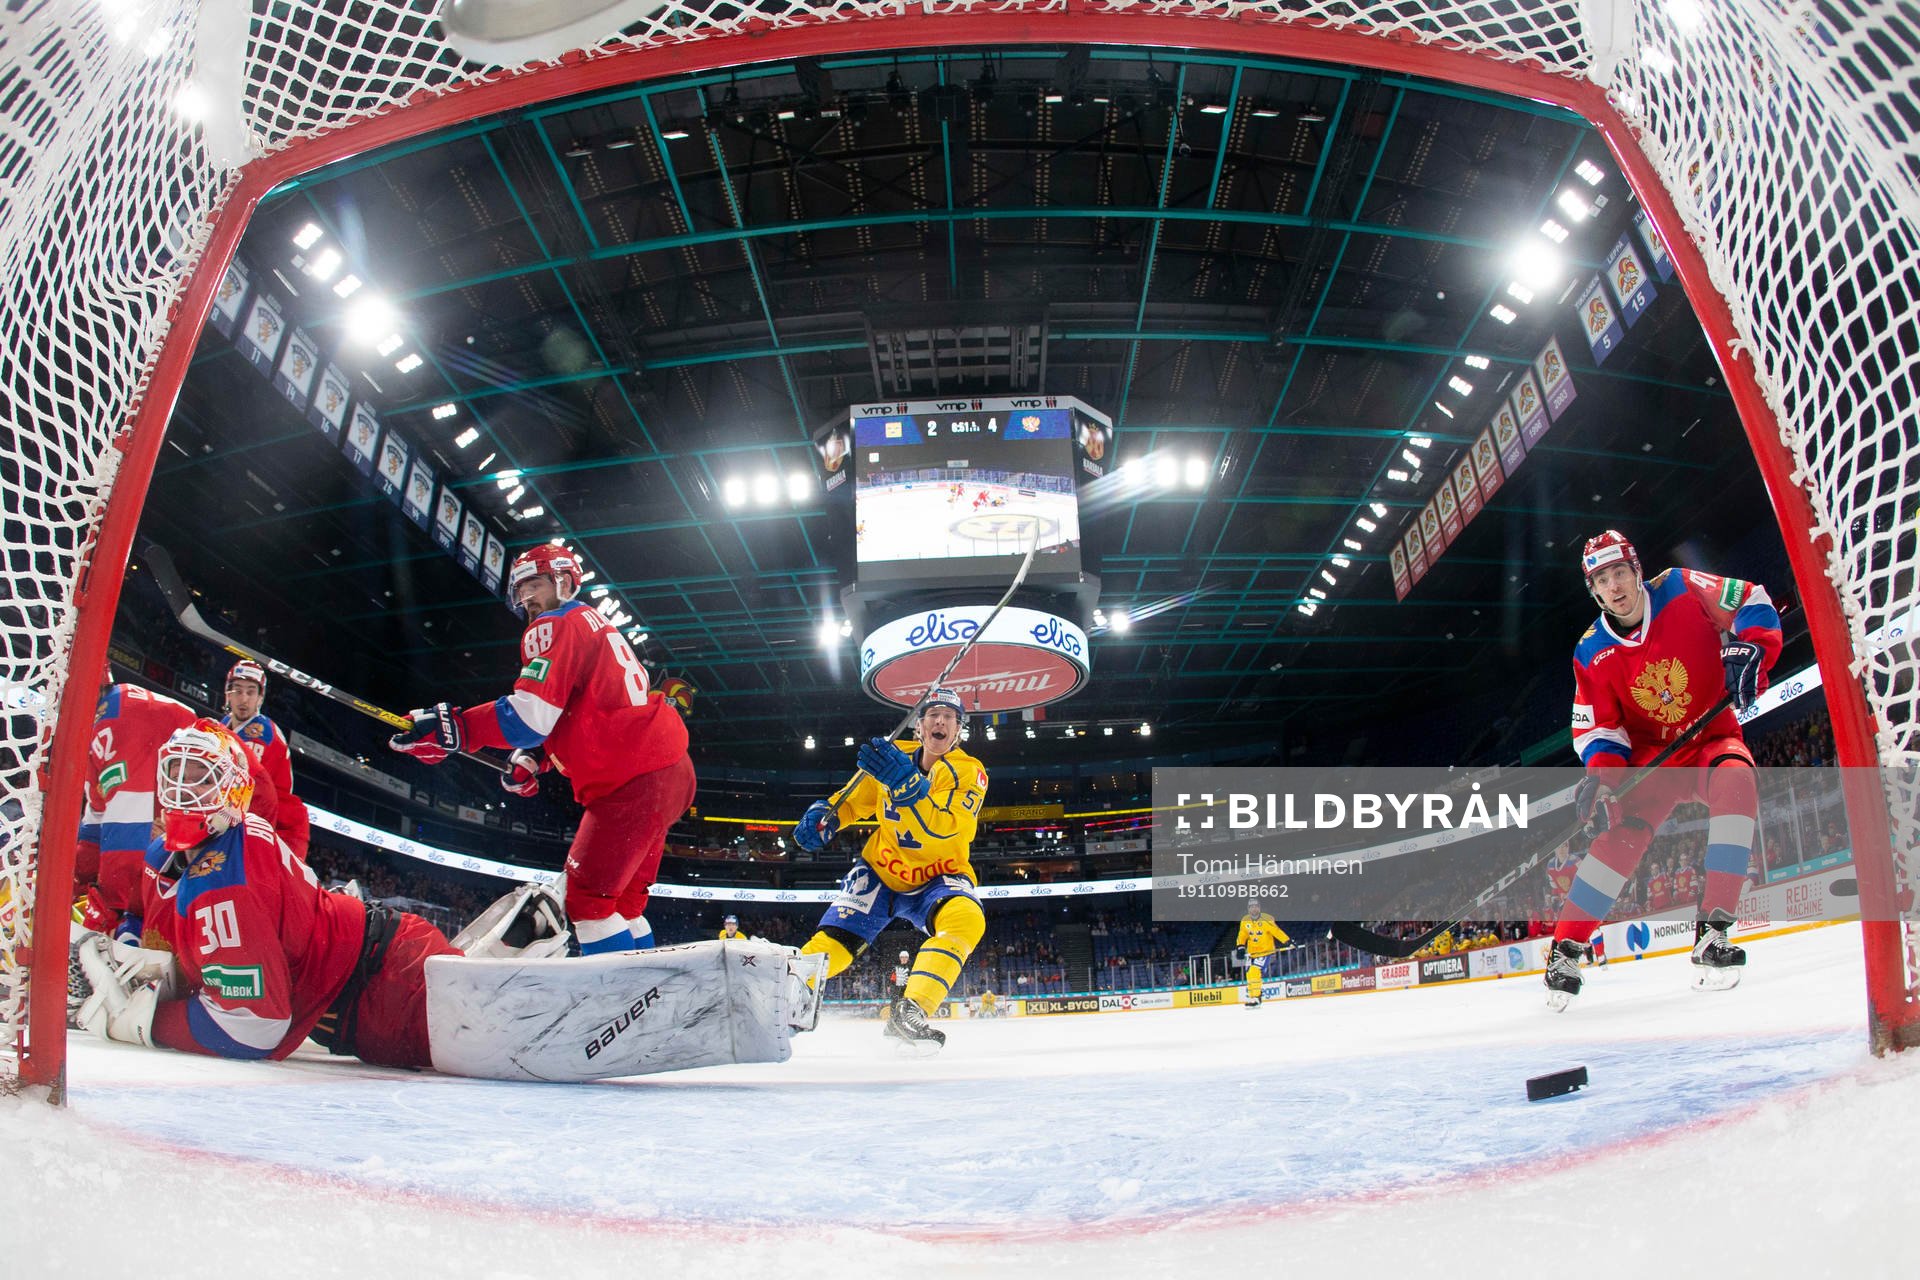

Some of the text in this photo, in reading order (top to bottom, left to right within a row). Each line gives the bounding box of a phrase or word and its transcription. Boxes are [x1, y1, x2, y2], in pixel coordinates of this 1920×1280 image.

[1631, 291, 1646, 312] 15
[1602, 334, 1611, 349] 5
[862, 399, 1042, 415] vmp vmp vmp
[927, 420, 937, 436] 2
[988, 418, 997, 432] 4
[524, 622, 553, 659] 88
[906, 613, 1082, 656] elisa elisa
[1593, 648, 1615, 666] CCM
[1720, 648, 1751, 659] UER
[268, 658, 334, 697] CCM
[606, 633, 650, 707] 8
[894, 674, 1057, 697] Milwaee
[1780, 681, 1804, 701] elisa
[438, 703, 454, 745] AUER
[962, 789, 984, 818] 51
[988, 888, 1009, 897] elisa
[1030, 886, 1052, 895] elisa
[1072, 884, 1094, 893] elisa
[1115, 881, 1136, 891] elisa
[1476, 853, 1538, 907] CCM
[1786, 883, 1808, 904] RED
[1737, 897, 1757, 915] RED
[1786, 899, 1823, 915] MACHINE
[195, 900, 241, 955] 30
[1737, 911, 1770, 928] MACHINE
[1654, 921, 1696, 939] NORNICKE
[1423, 958, 1463, 976] OPTIMERA
[1050, 1000, 1098, 1011] XL-BYGG
[1102, 997, 1138, 1008] DALOC
[585, 986, 662, 1061] BAUER
